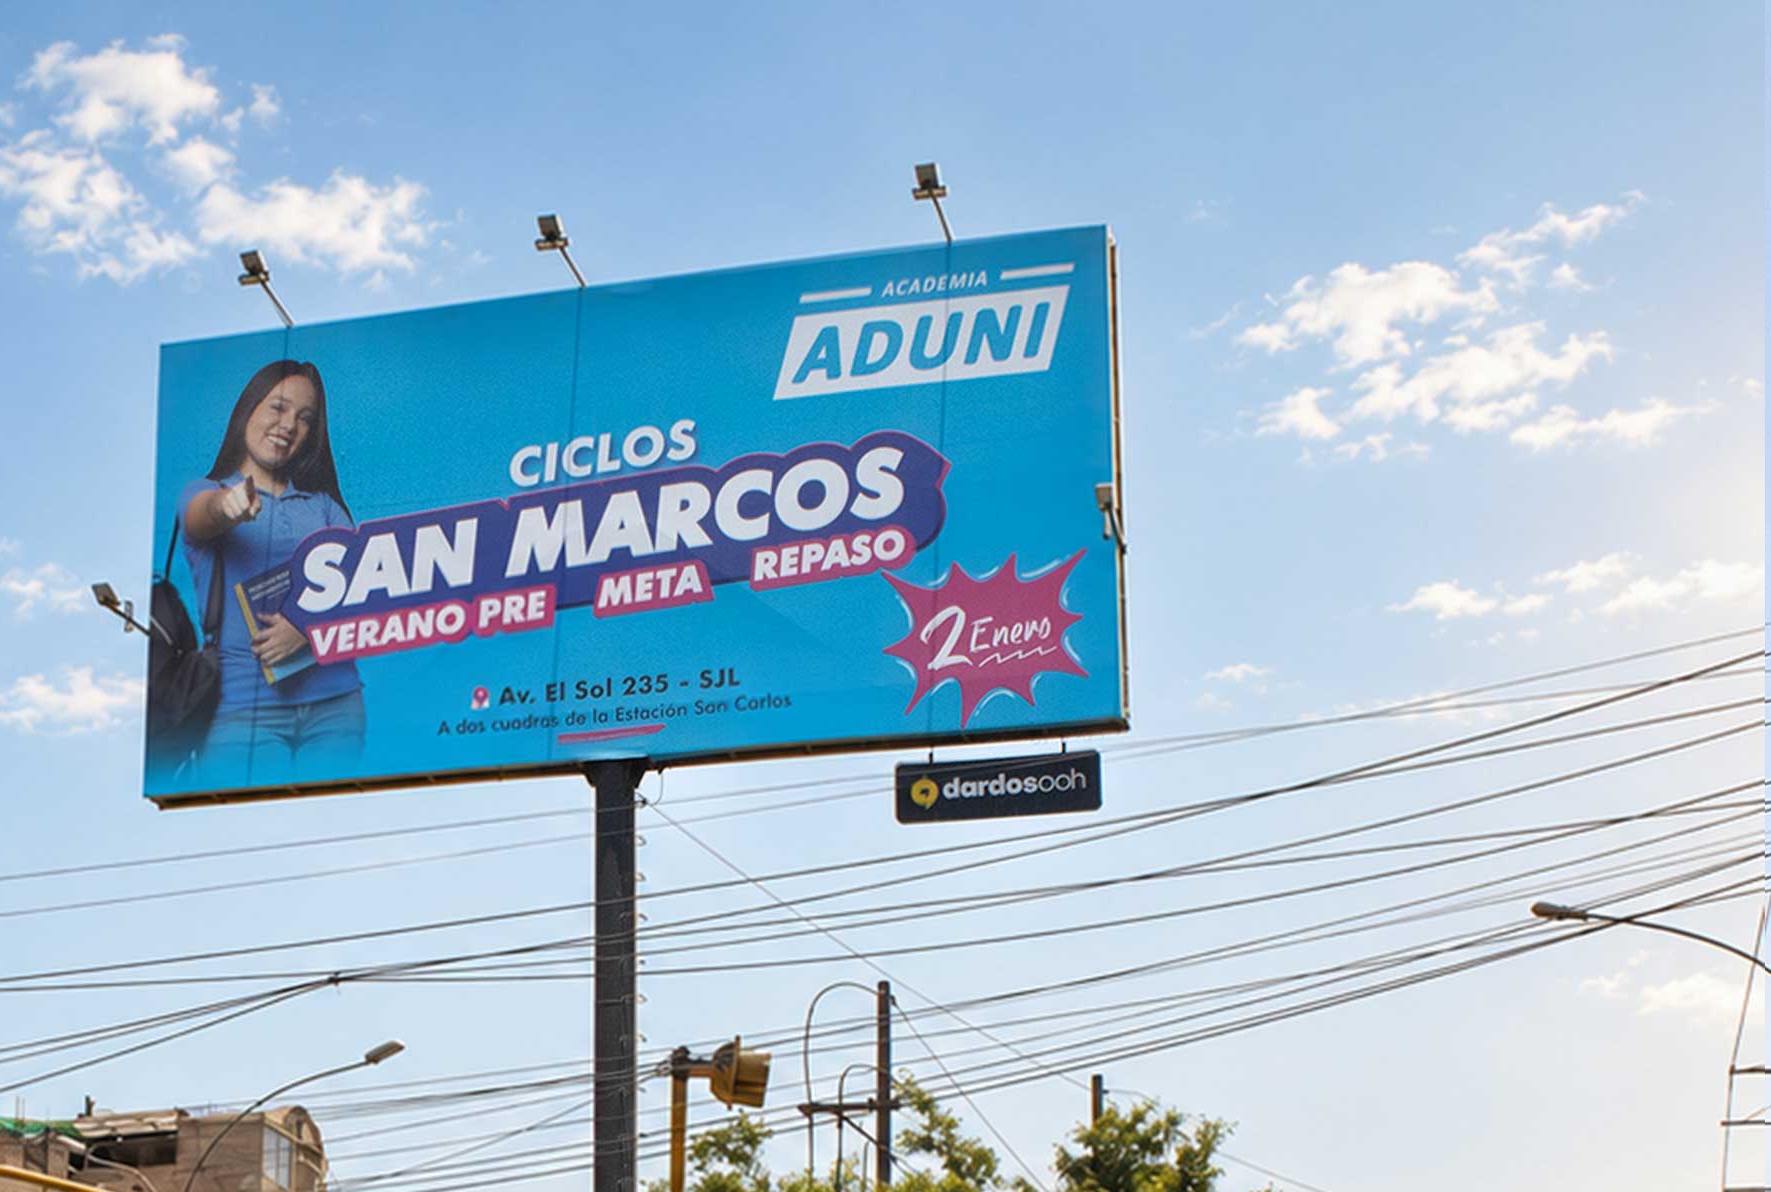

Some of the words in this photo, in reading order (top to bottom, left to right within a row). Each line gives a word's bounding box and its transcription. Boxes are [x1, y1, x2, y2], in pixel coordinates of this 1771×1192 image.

[881, 271, 988, 298] ACADEMIA
[791, 301, 1051, 384] ADUNI
[509, 419, 697, 487] CICLOS
[297, 517, 478, 613] SAN
[505, 447, 905, 578] MARCOS
[754, 530, 906, 582] REPASO
[597, 565, 703, 609] META
[311, 603, 466, 656] VERANO
[478, 590, 547, 629] PRE
[920, 605, 973, 671] 2
[969, 616, 1051, 653] Enero
[499, 686, 535, 705] Av.
[545, 681, 566, 702] El
[575, 677, 612, 700] Sol
[622, 674, 669, 696] 235
[699, 668, 741, 689] SJL
[437, 721, 451, 736] A
[456, 719, 485, 735] dos
[491, 715, 559, 732] cuadras
[565, 711, 586, 726] de
[593, 708, 608, 724] la
[615, 703, 688, 722] Estación
[694, 699, 728, 716] San
[734, 693, 792, 711] Carlos
[943, 768, 1087, 799] dardosooh
